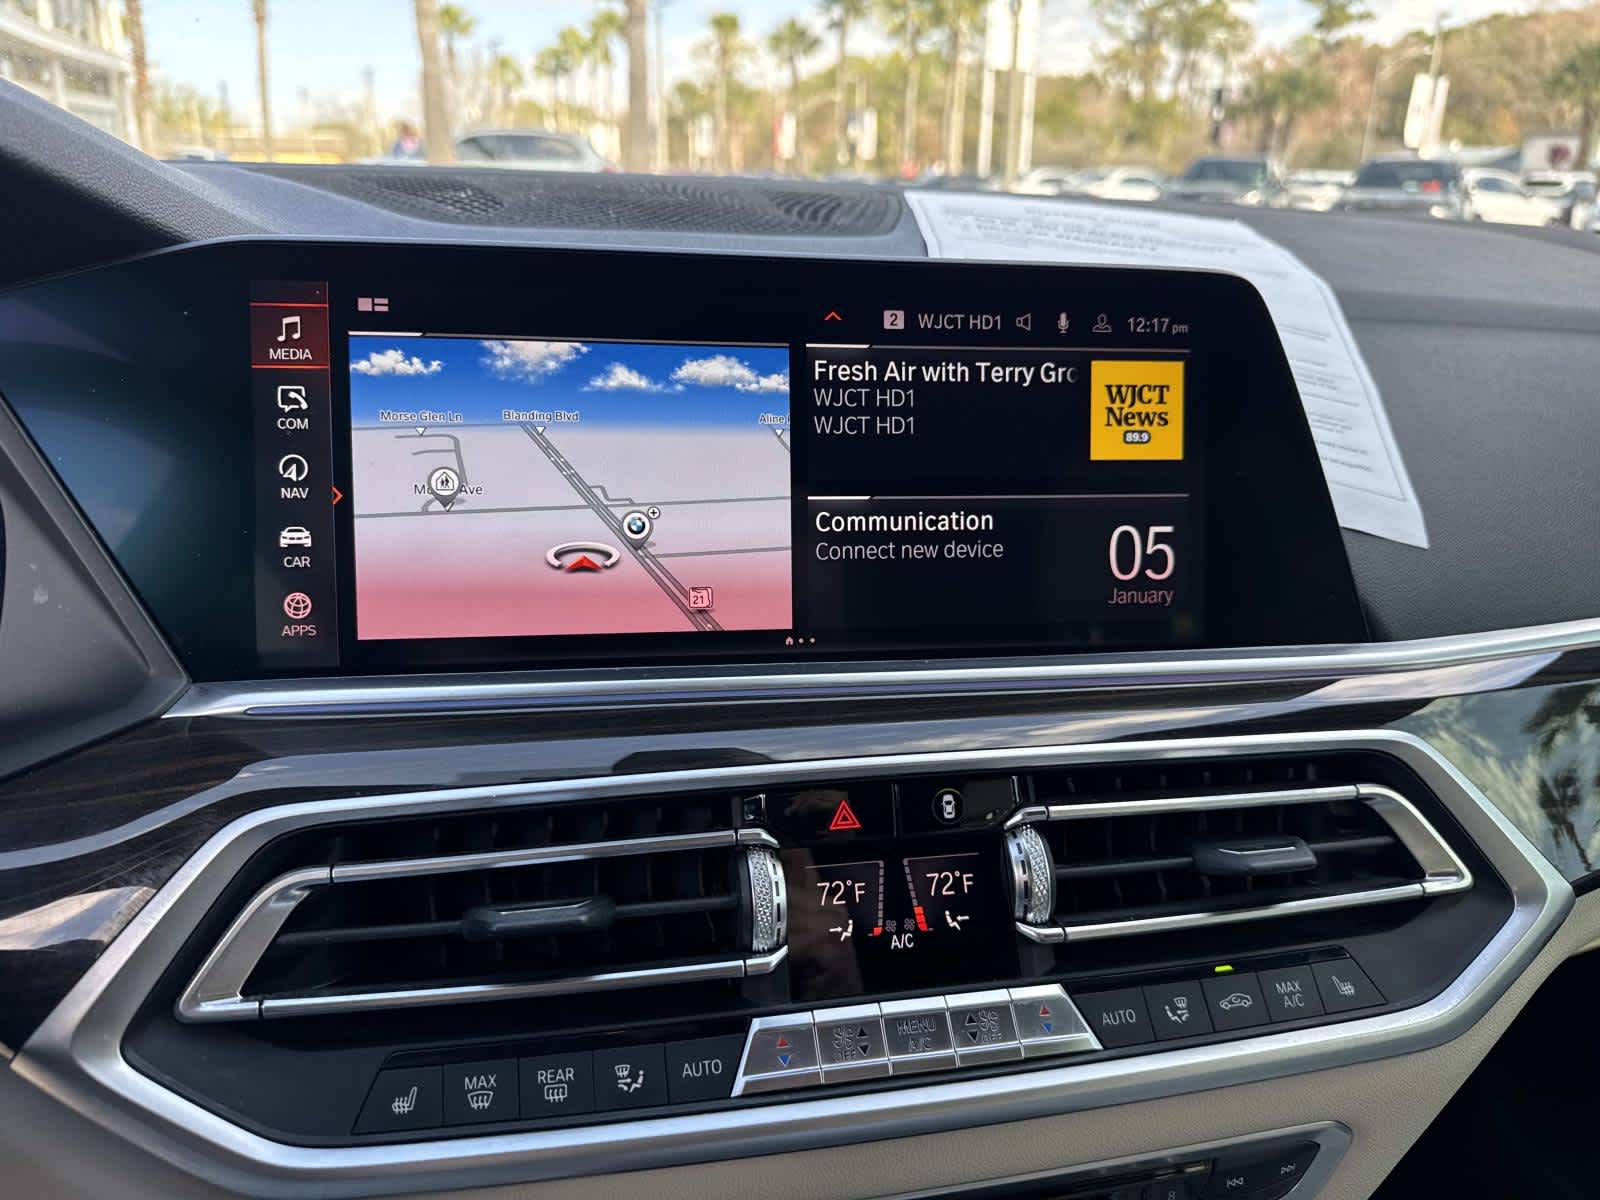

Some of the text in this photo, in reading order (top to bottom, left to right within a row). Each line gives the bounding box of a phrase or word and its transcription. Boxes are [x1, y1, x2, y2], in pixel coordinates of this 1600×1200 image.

[889, 314, 898, 327] 2
[918, 314, 1002, 331] WJCT HD1
[1127, 317, 1189, 335] 12:17 pm
[269, 348, 313, 361] MEDIA
[814, 360, 878, 382] Fresh
[883, 361, 917, 382] Air
[921, 361, 969, 383] with
[975, 362, 1035, 387] Terry
[814, 388, 915, 408] WJCT HD1
[1104, 384, 1170, 407] WJCT
[277, 417, 309, 430] COM
[379, 411, 463, 422] Morse Glen Ln
[503, 410, 579, 422] Blanding Blvd
[759, 414, 785, 424] Aline
[1105, 407, 1169, 427] News
[814, 416, 915, 435] WJCT HD1
[1125, 431, 1149, 443] 89.9
[281, 487, 309, 499] NAV
[460, 484, 483, 495] Ave
[815, 511, 994, 532] Communication
[815, 540, 1004, 560] Connect new device
[1109, 525, 1175, 581] 05
[284, 556, 311, 568] CAR
[693, 595, 704, 605] 21
[1108, 588, 1174, 606] January
[281, 625, 317, 637] APPS
[890, 933, 914, 950] A/C
[1275, 981, 1302, 994] MAX
[1283, 995, 1304, 1008] A/C
[1101, 1008, 1137, 1026] AUTO
[537, 1068, 575, 1083] REAR
[682, 1059, 722, 1077] AUTO
[464, 1075, 497, 1090] MAX
